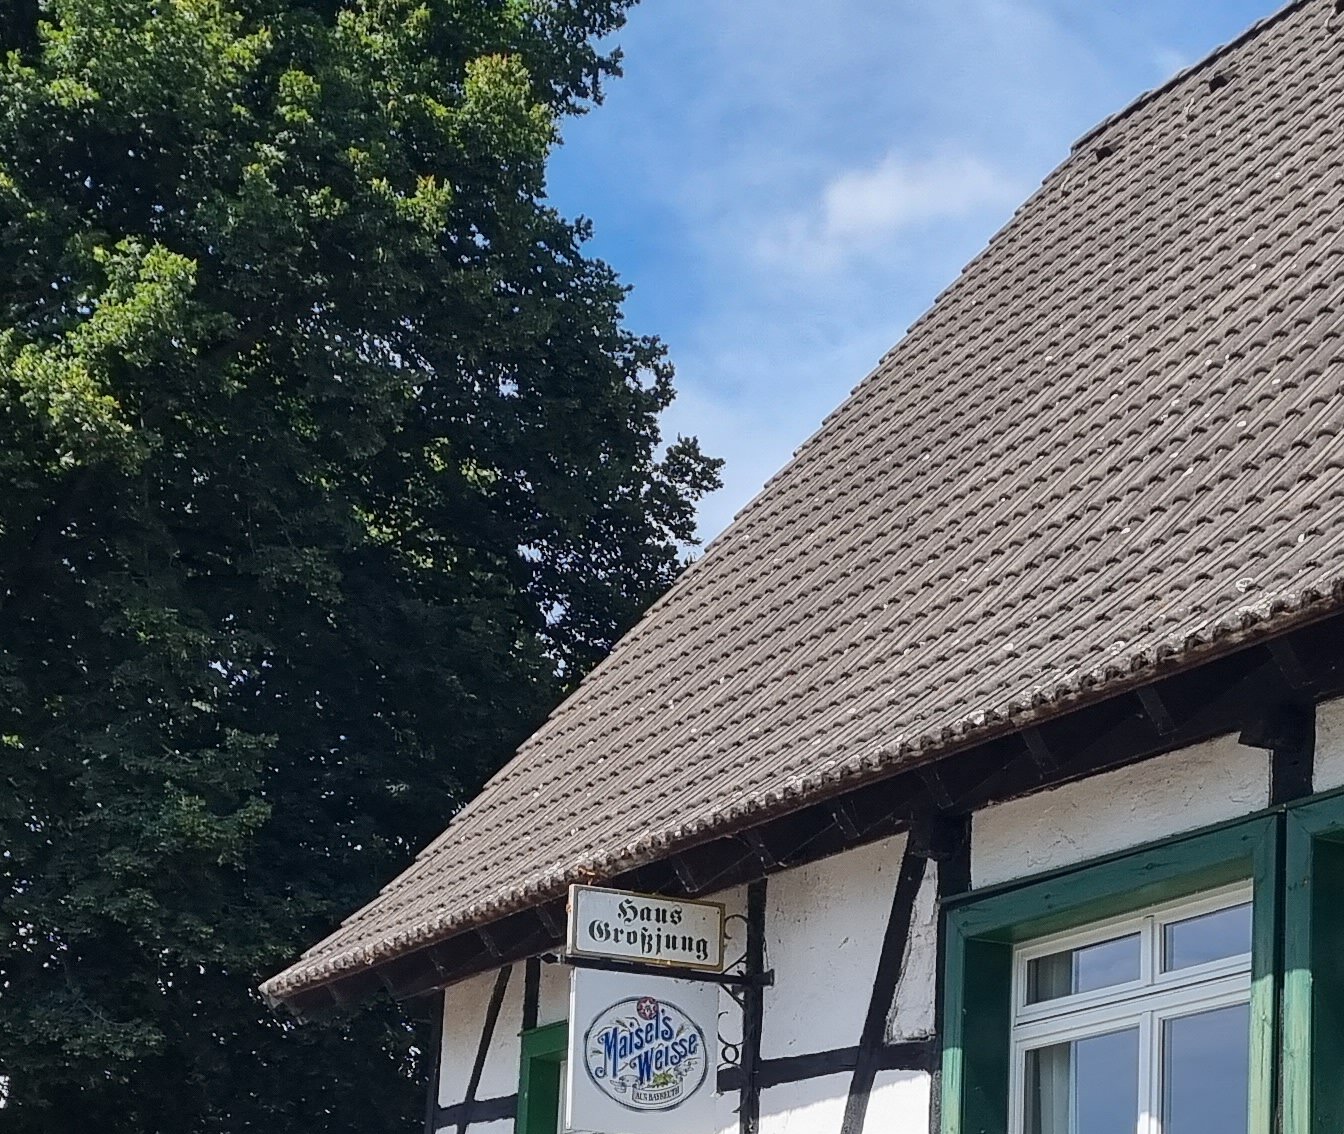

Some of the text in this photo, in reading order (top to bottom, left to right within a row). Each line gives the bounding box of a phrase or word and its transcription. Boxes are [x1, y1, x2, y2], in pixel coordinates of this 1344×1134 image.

[618, 898, 683, 926] Haus
[588, 919, 709, 961] Großjung
[595, 1008, 674, 1078] Maisel's
[629, 1033, 699, 1086] Weisse
